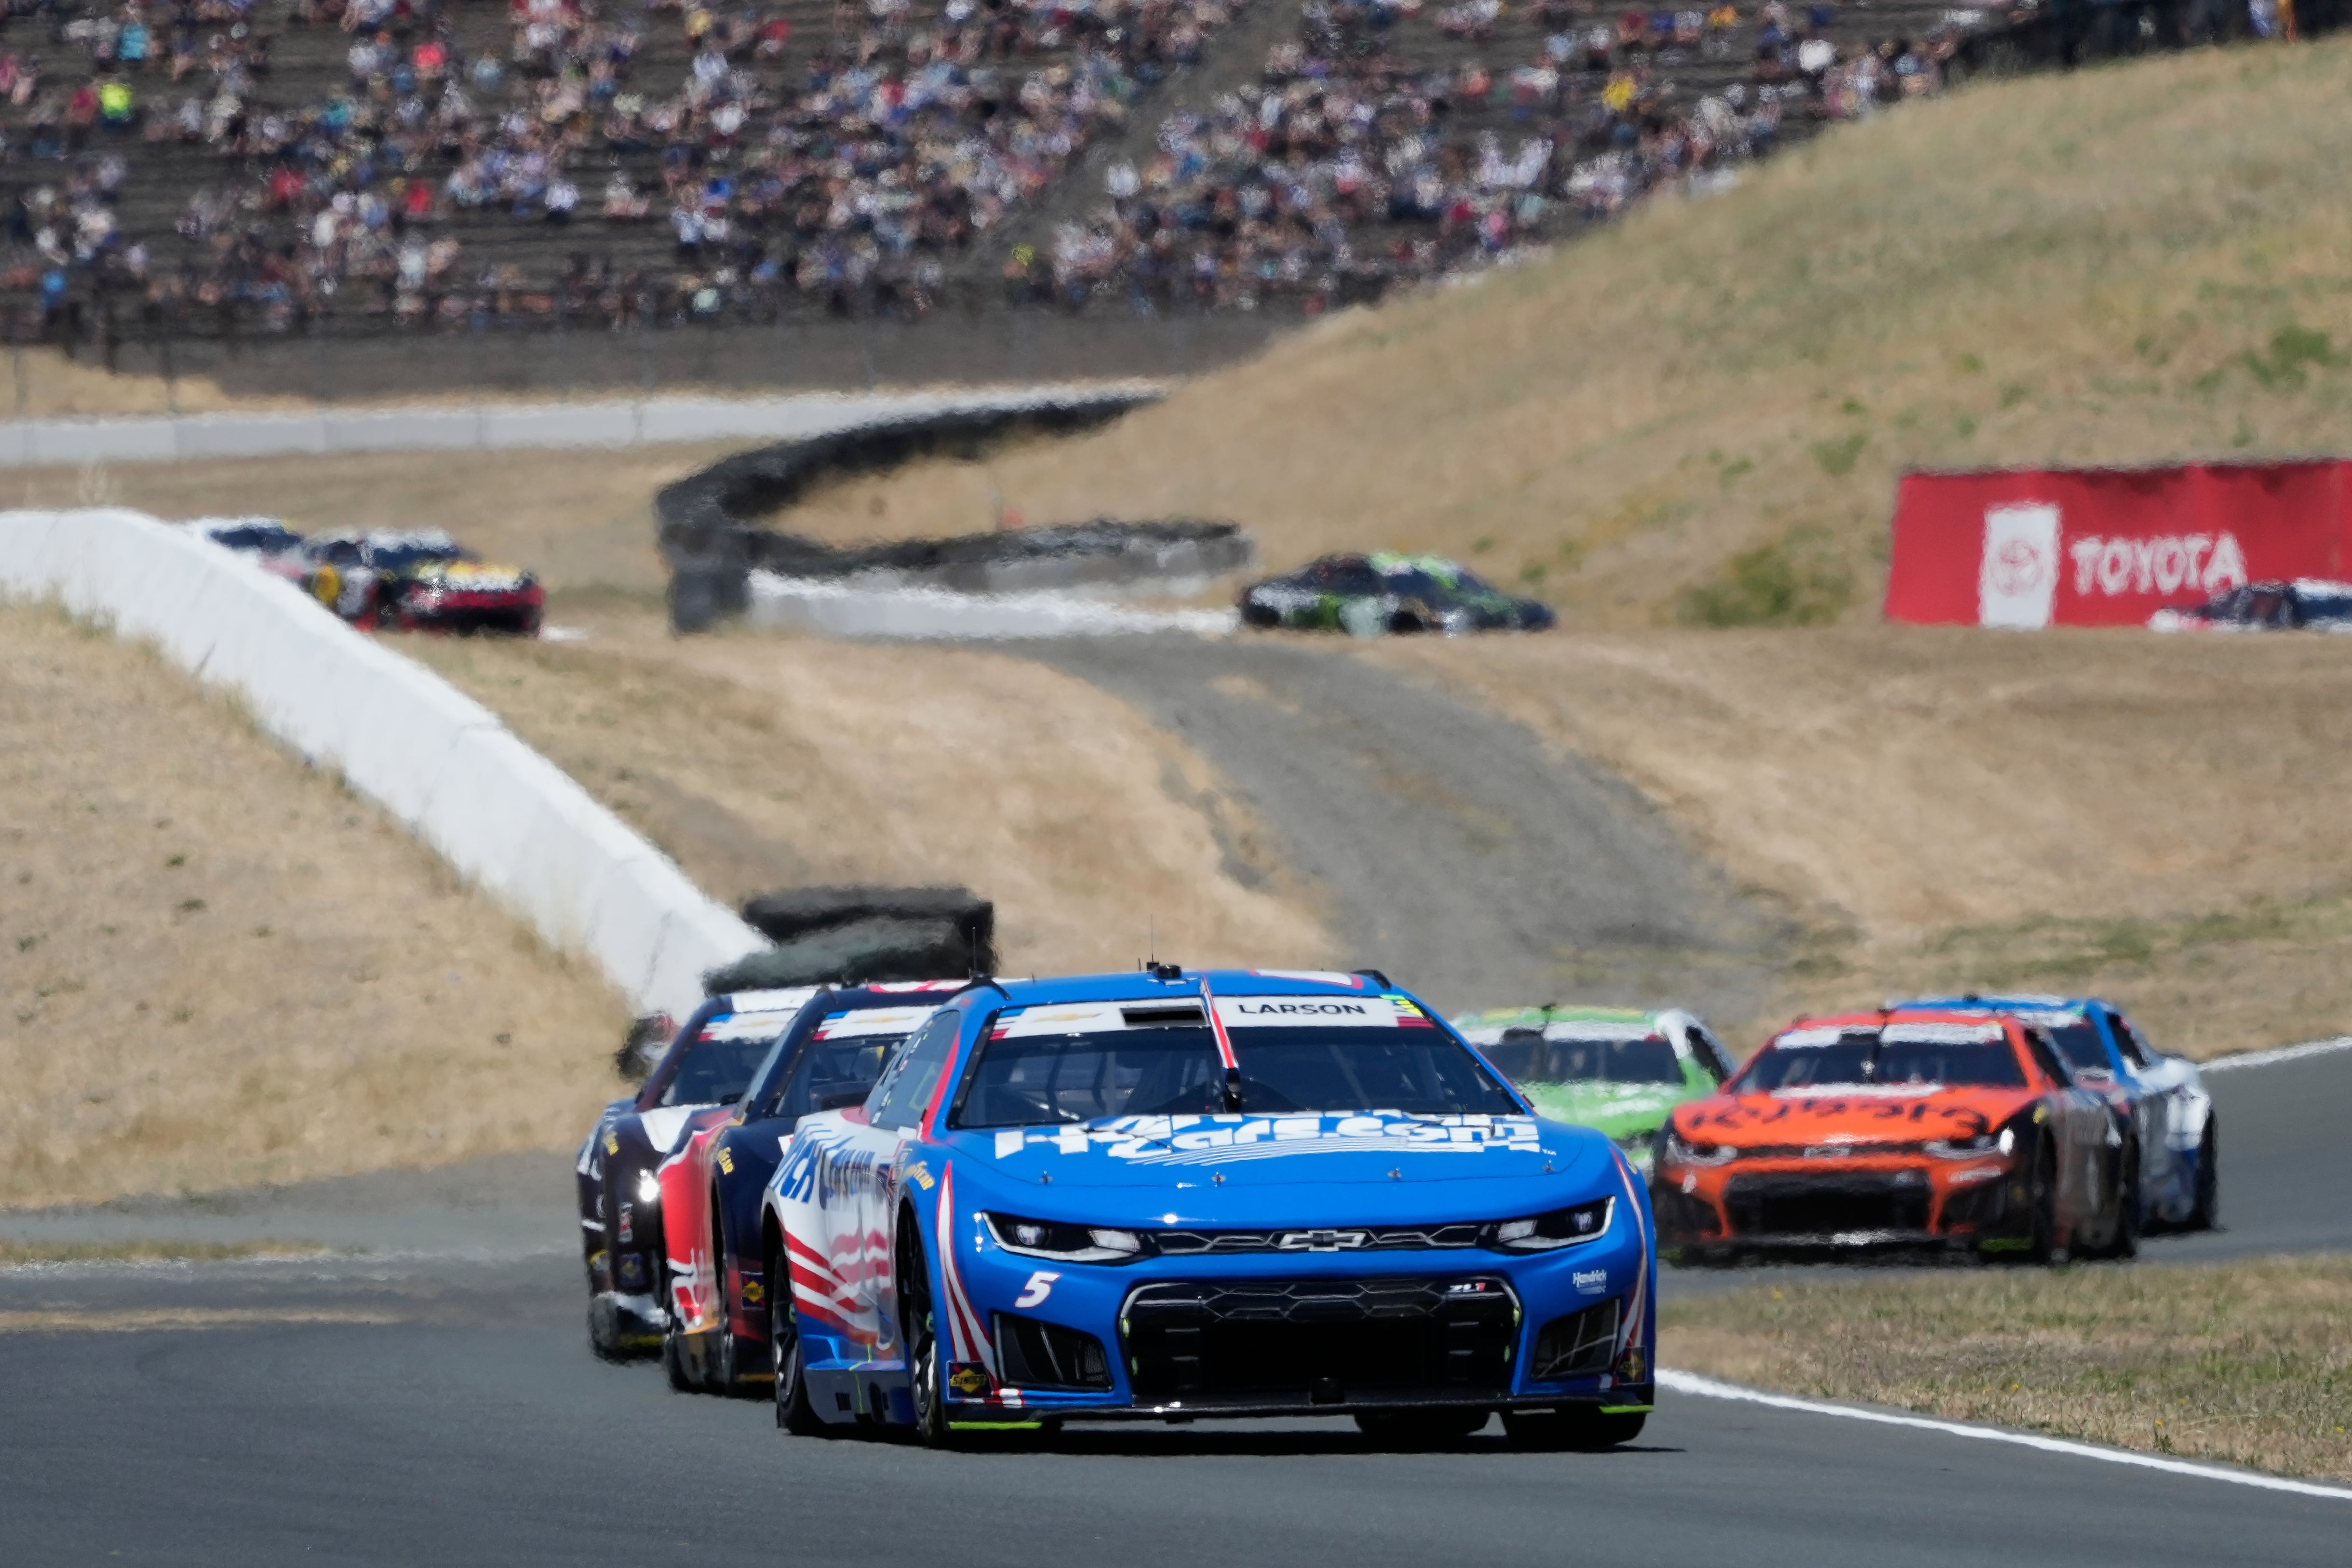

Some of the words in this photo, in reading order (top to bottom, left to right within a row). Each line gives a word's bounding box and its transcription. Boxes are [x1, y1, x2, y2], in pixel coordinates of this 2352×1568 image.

[2070, 532, 2247, 596] TOYOTA
[1238, 1004, 1367, 1014] LARSON
[1014, 1271, 1063, 1309] 5
